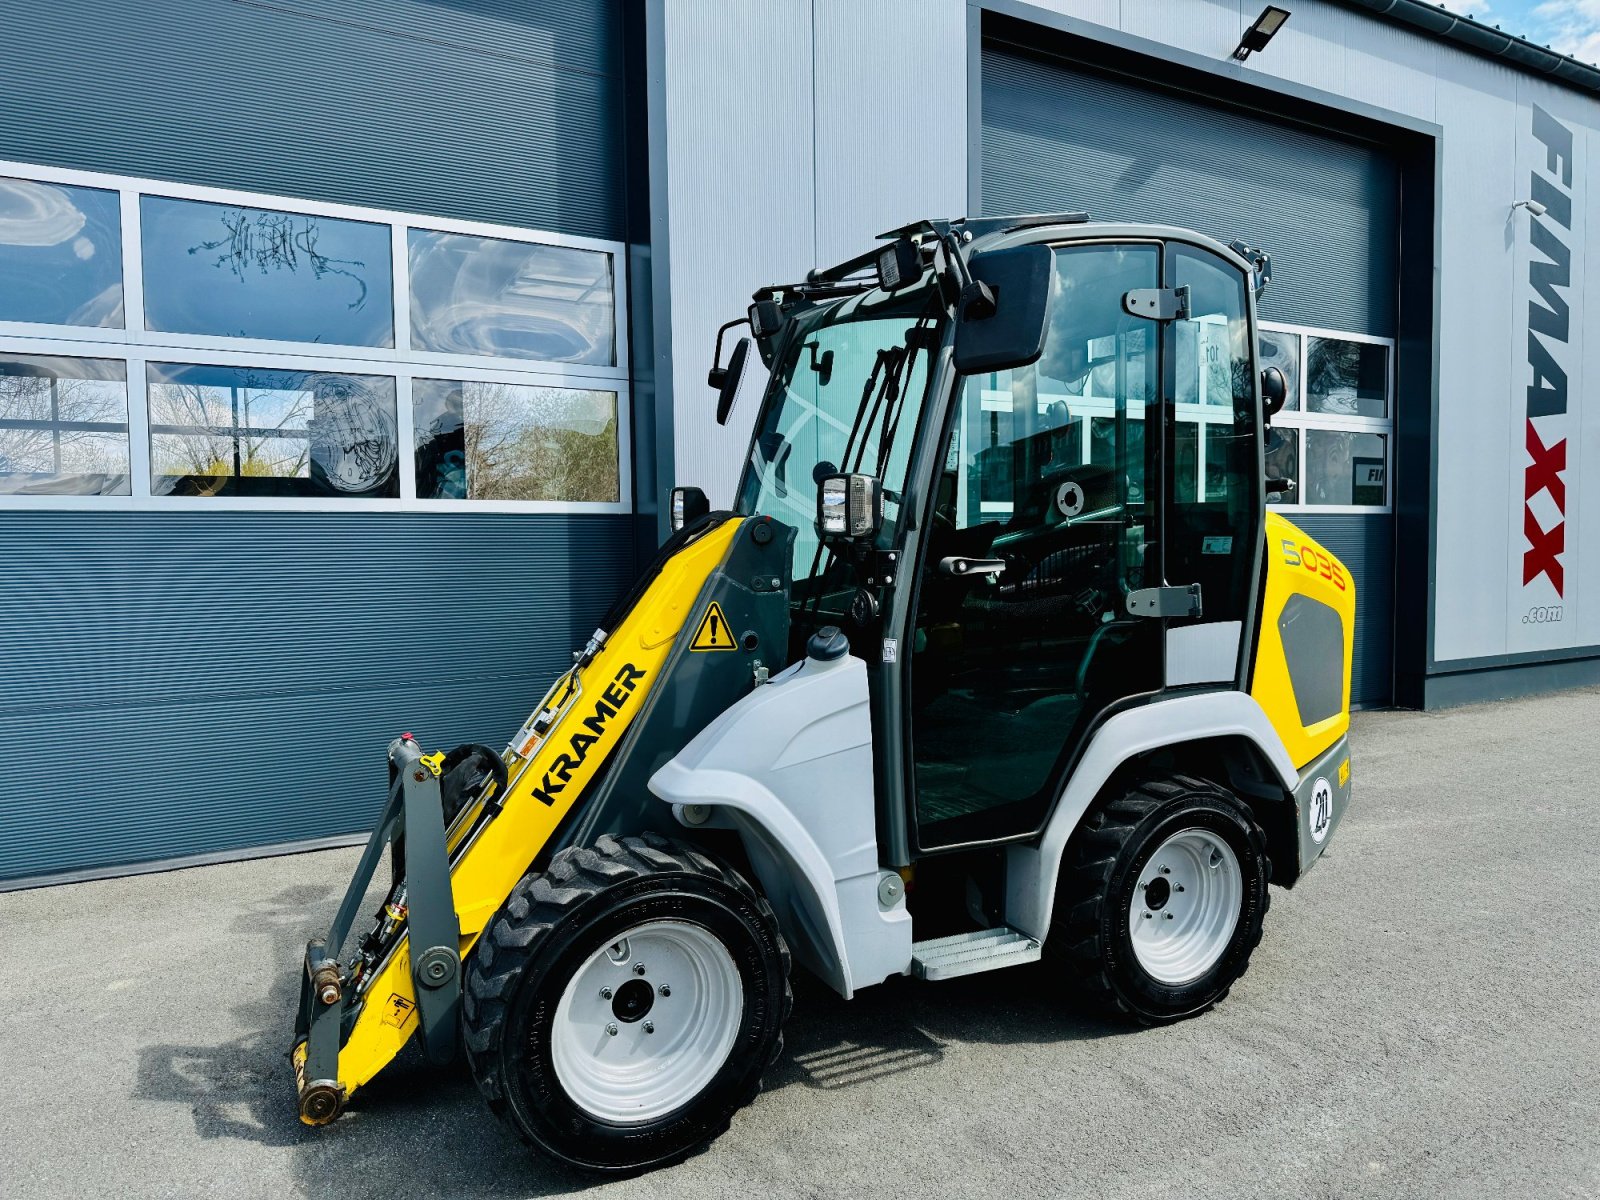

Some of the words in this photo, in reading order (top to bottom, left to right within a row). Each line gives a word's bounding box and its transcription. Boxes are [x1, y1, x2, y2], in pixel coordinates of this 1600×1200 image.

[1521, 102, 1573, 600] FIMAXX
[1281, 539, 1346, 591] 5035
[1522, 605, 1563, 624] .com
[531, 663, 647, 807] KRAMER
[1314, 788, 1328, 833] 20
